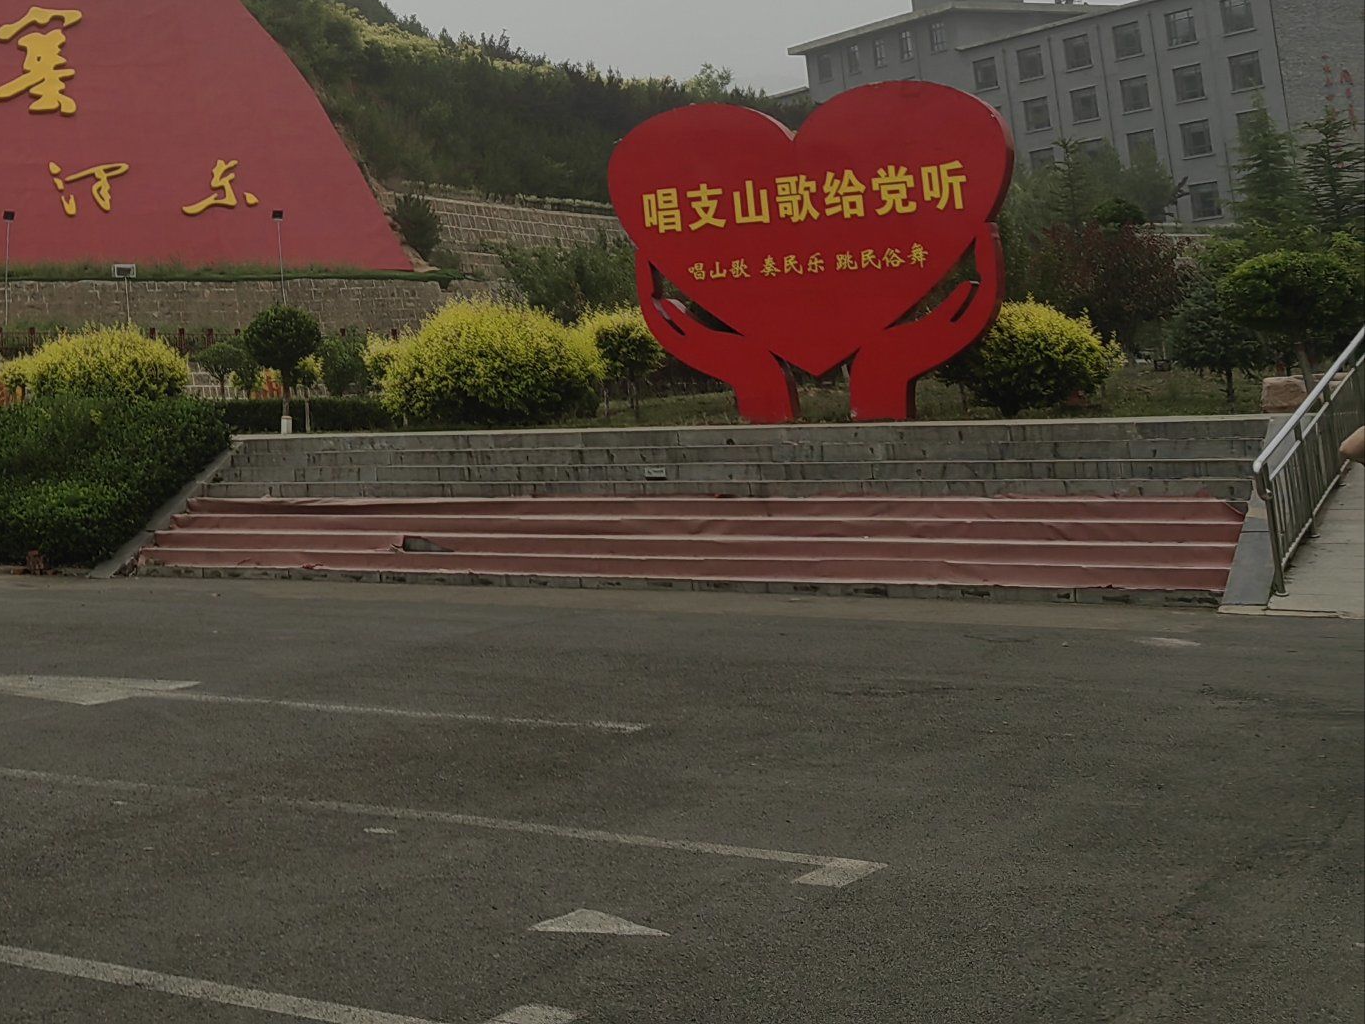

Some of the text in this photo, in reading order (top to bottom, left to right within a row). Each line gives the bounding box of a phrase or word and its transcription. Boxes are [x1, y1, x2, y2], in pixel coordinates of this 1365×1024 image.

[642, 160, 967, 234] 唱支山歌给党听
[688, 242, 929, 281] 唱山歌 奏民乐 跳民俗舞
